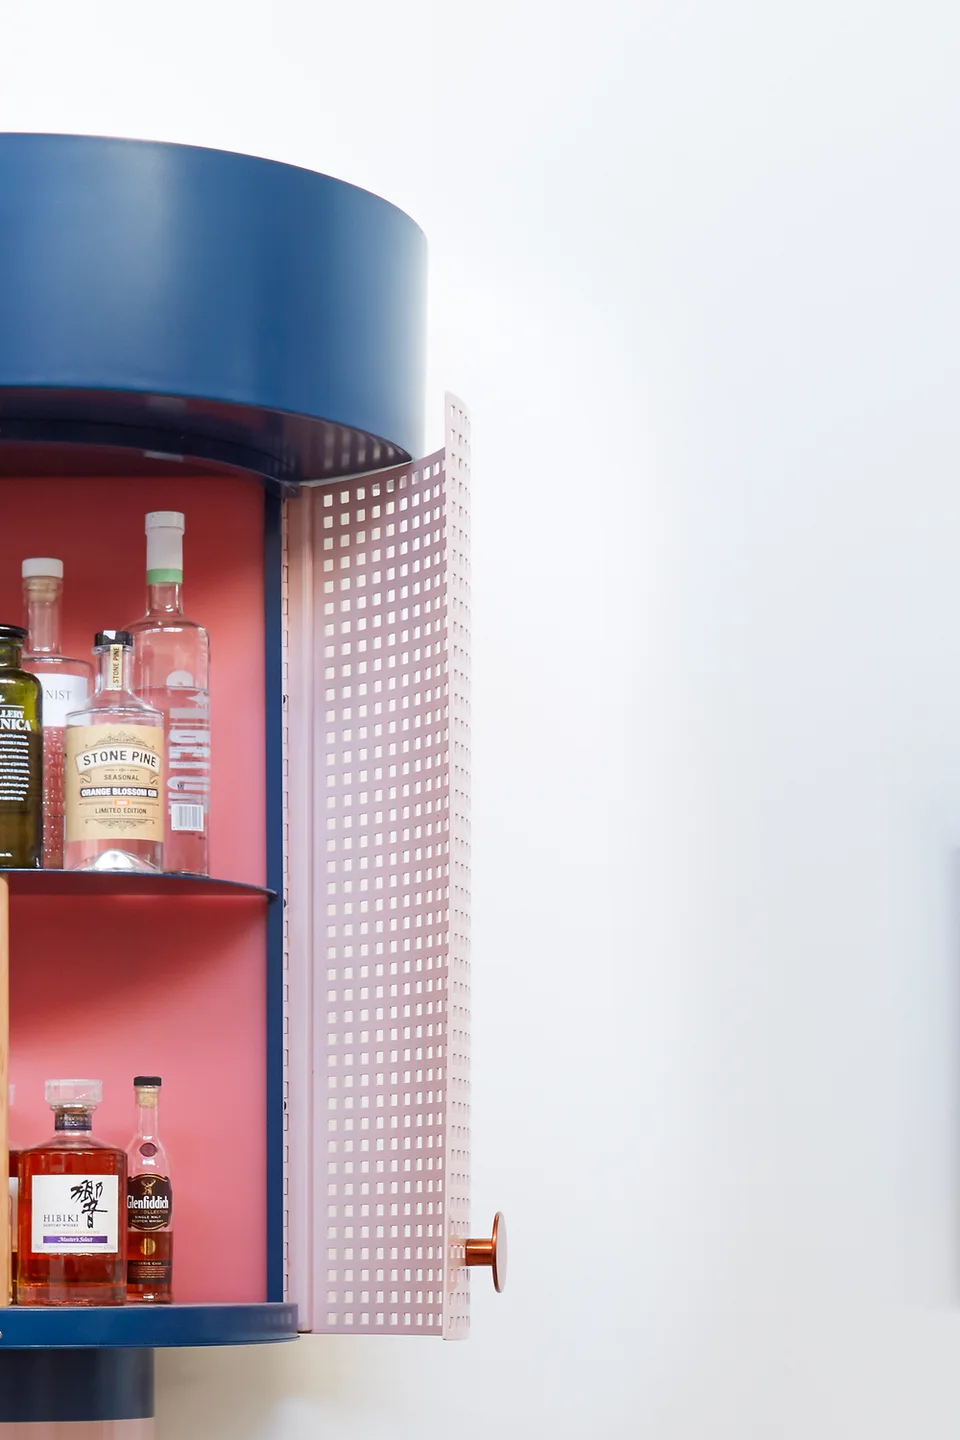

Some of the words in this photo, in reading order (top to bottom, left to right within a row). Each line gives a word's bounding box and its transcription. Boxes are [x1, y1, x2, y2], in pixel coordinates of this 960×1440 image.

[83, 750, 127, 766] STONE
[131, 751, 157, 767] PINE
[81, 787, 111, 797] ORANGE
[112, 787, 147, 797] BLOSSOM
[70, 1179, 108, 1229] 響
[127, 1195, 169, 1209] Glenfiddich
[43, 1214, 79, 1222] HIBIKI
